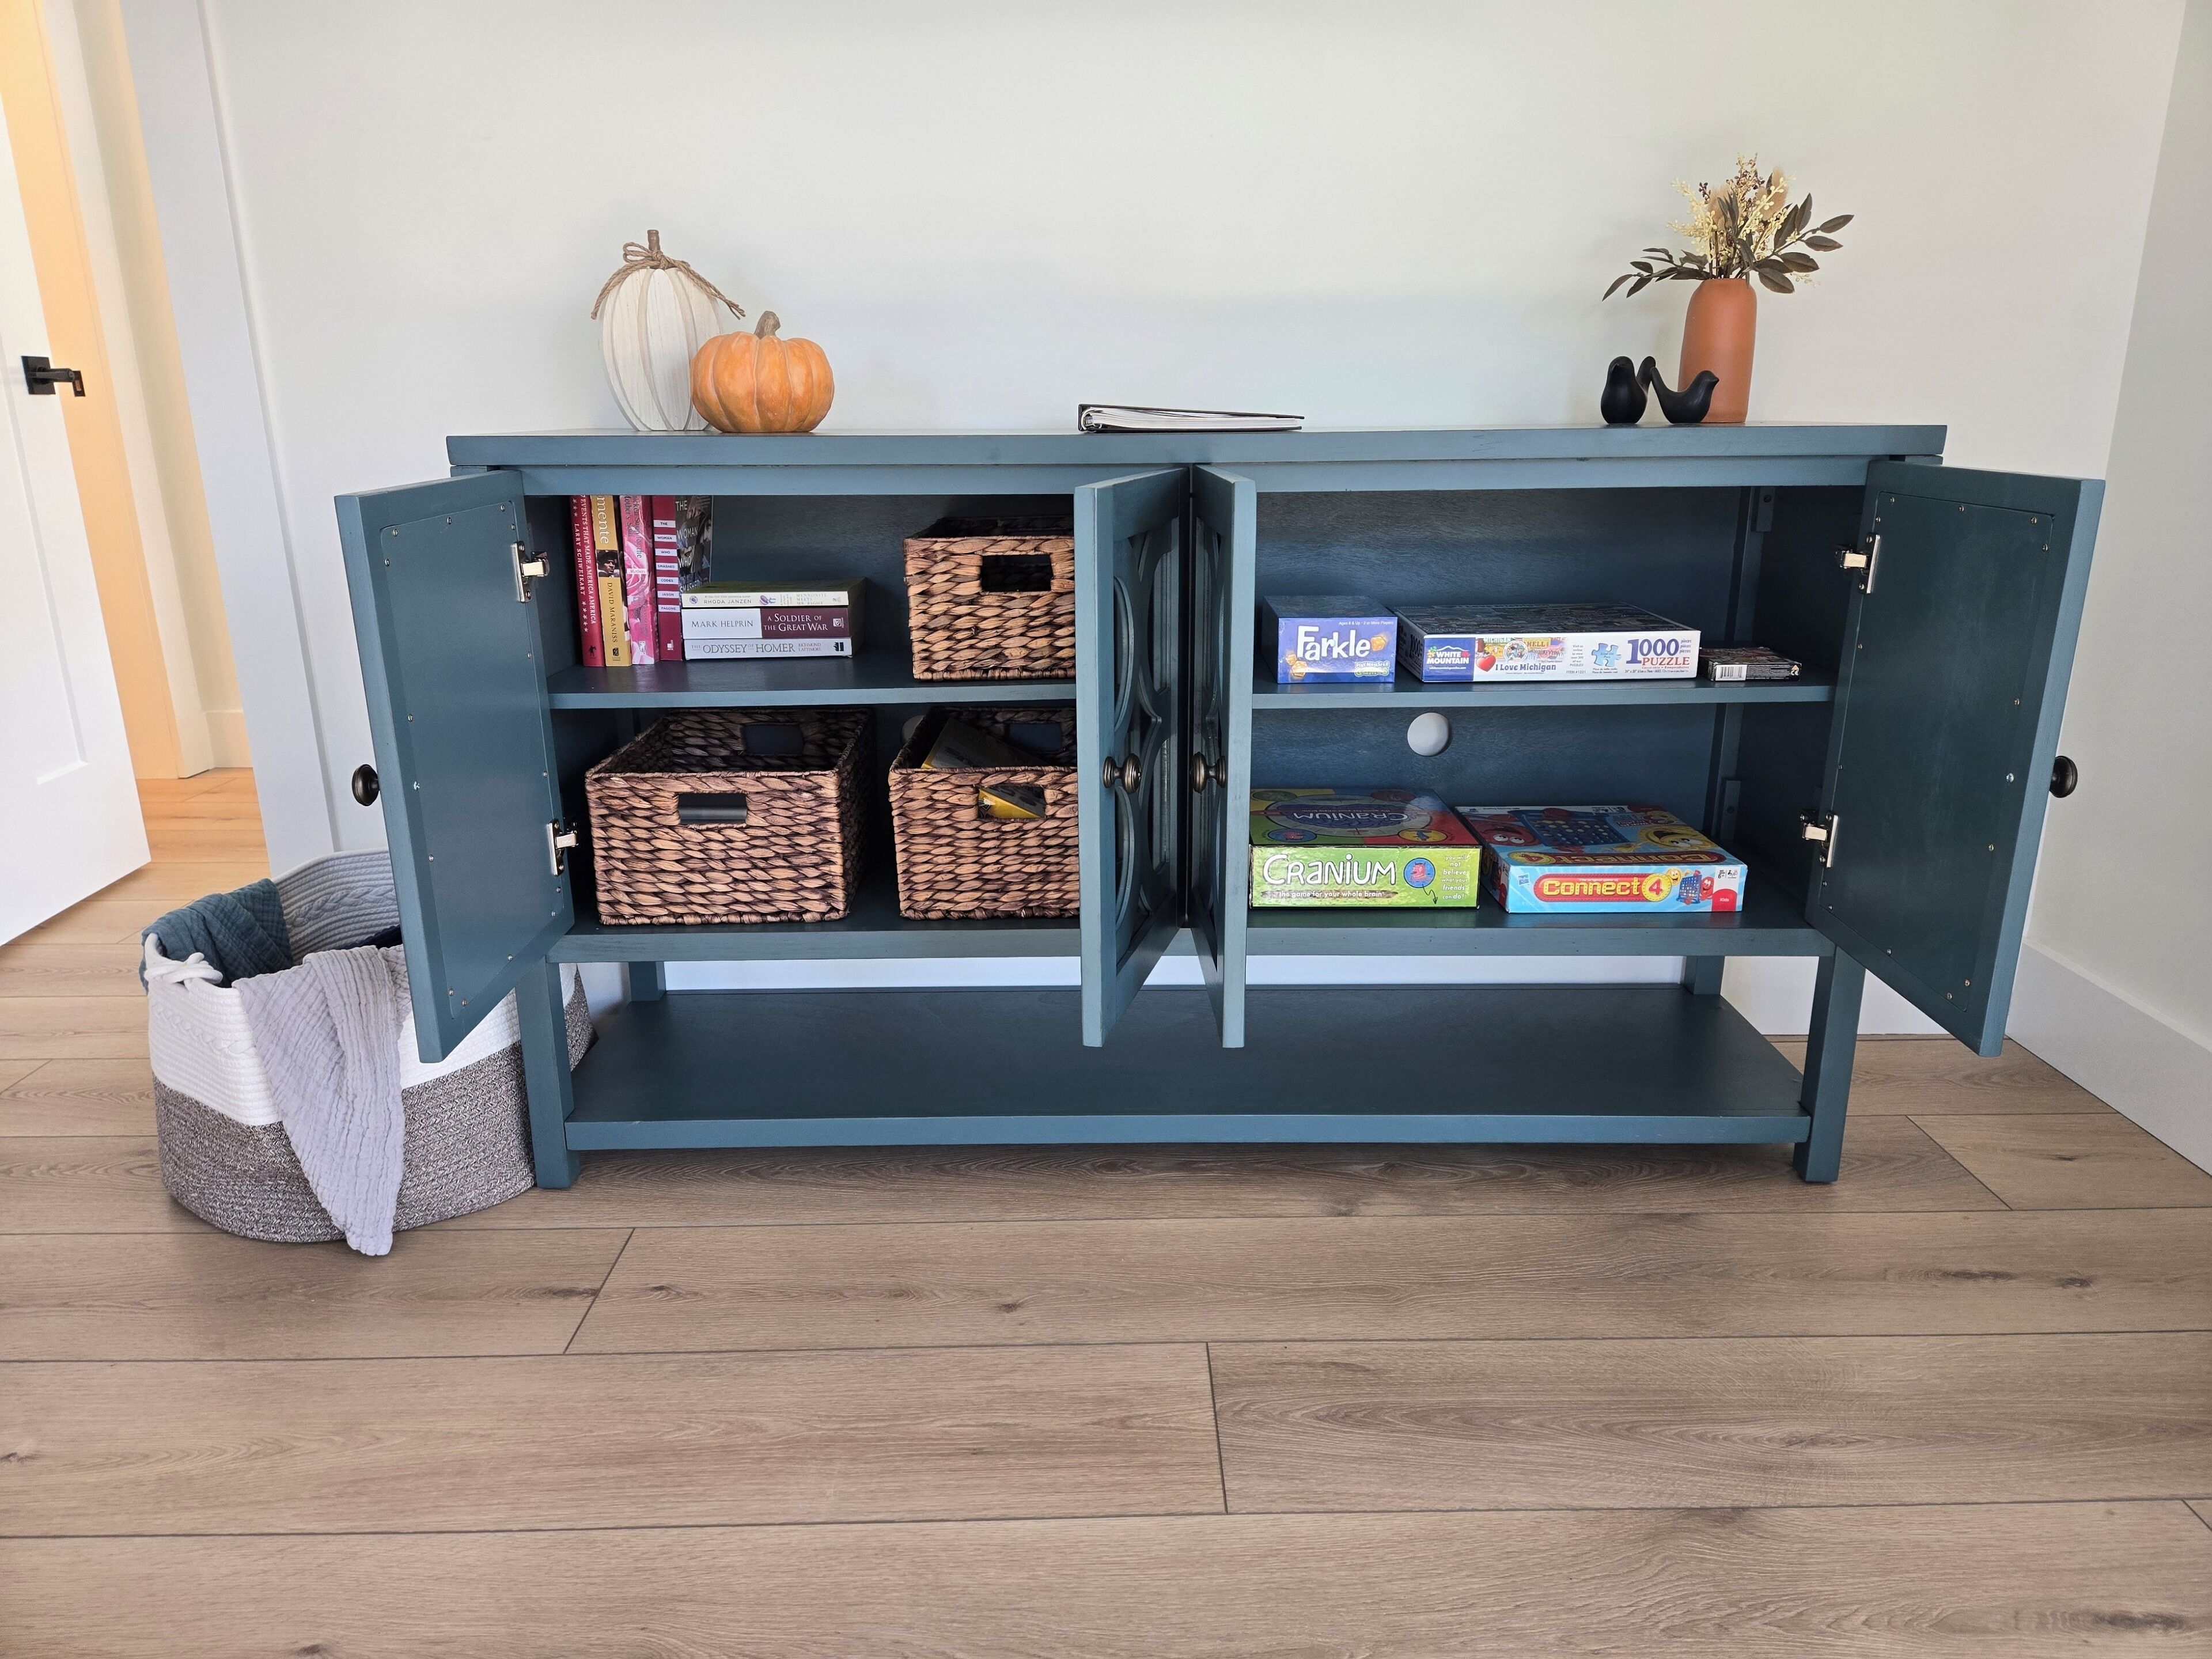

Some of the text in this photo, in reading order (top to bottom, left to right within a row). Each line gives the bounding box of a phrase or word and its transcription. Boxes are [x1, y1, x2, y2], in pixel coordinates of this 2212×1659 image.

[676, 500, 688, 512] THE
[596, 495, 609, 544] mente
[676, 527, 698, 541] WOMAN
[677, 555, 692, 569] WHO
[577, 548, 585, 595] SCHWEIKART
[585, 565, 594, 594] AMERICA
[588, 596, 597, 624] AMERICA
[774, 613, 811, 622] SOLDIER
[609, 607, 618, 643] MARANISS
[778, 623, 806, 631] GREAT
[807, 623, 828, 631] WAR
[703, 644, 747, 653] ODYSSEY
[756, 643, 795, 653] HOMER
[1297, 625, 1371, 661] Farkle
[1626, 638, 1680, 664] 1000
[1519, 663, 1556, 672] Michigan
[1642, 656, 1690, 666] PUZZLE
[1557, 854, 1711, 863] Connect
[1543, 877, 1664, 896] Connect 4
